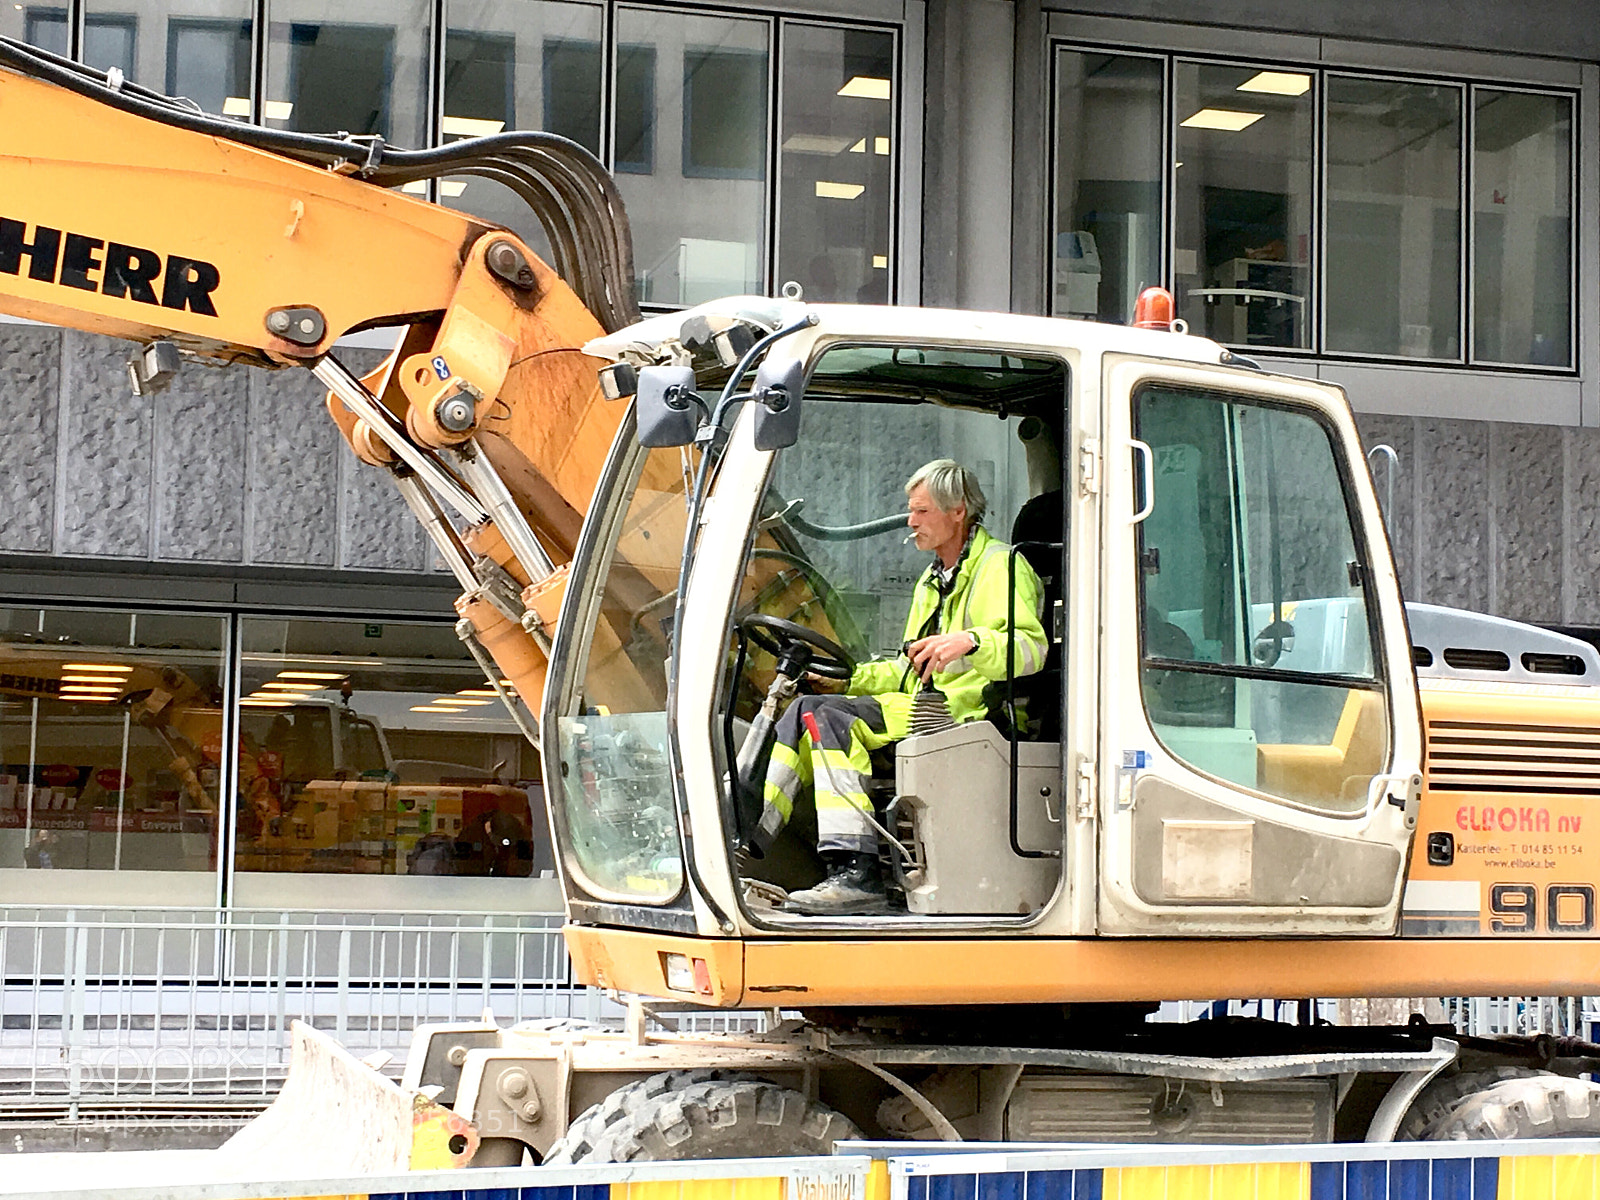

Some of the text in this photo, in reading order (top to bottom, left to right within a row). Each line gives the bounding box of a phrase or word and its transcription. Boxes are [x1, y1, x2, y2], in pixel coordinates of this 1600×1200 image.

[1456, 806, 1582, 833] ELBOKA nv
[1457, 843, 1501, 854] Kasterlee
[1521, 844, 1540, 854] 014
[1542, 844, 1554, 854] 85
[1557, 845, 1568, 854] 11
[1571, 844, 1583, 855] 54
[1484, 858, 1556, 869] www.elboka.be
[1488, 882, 1597, 935] 90
